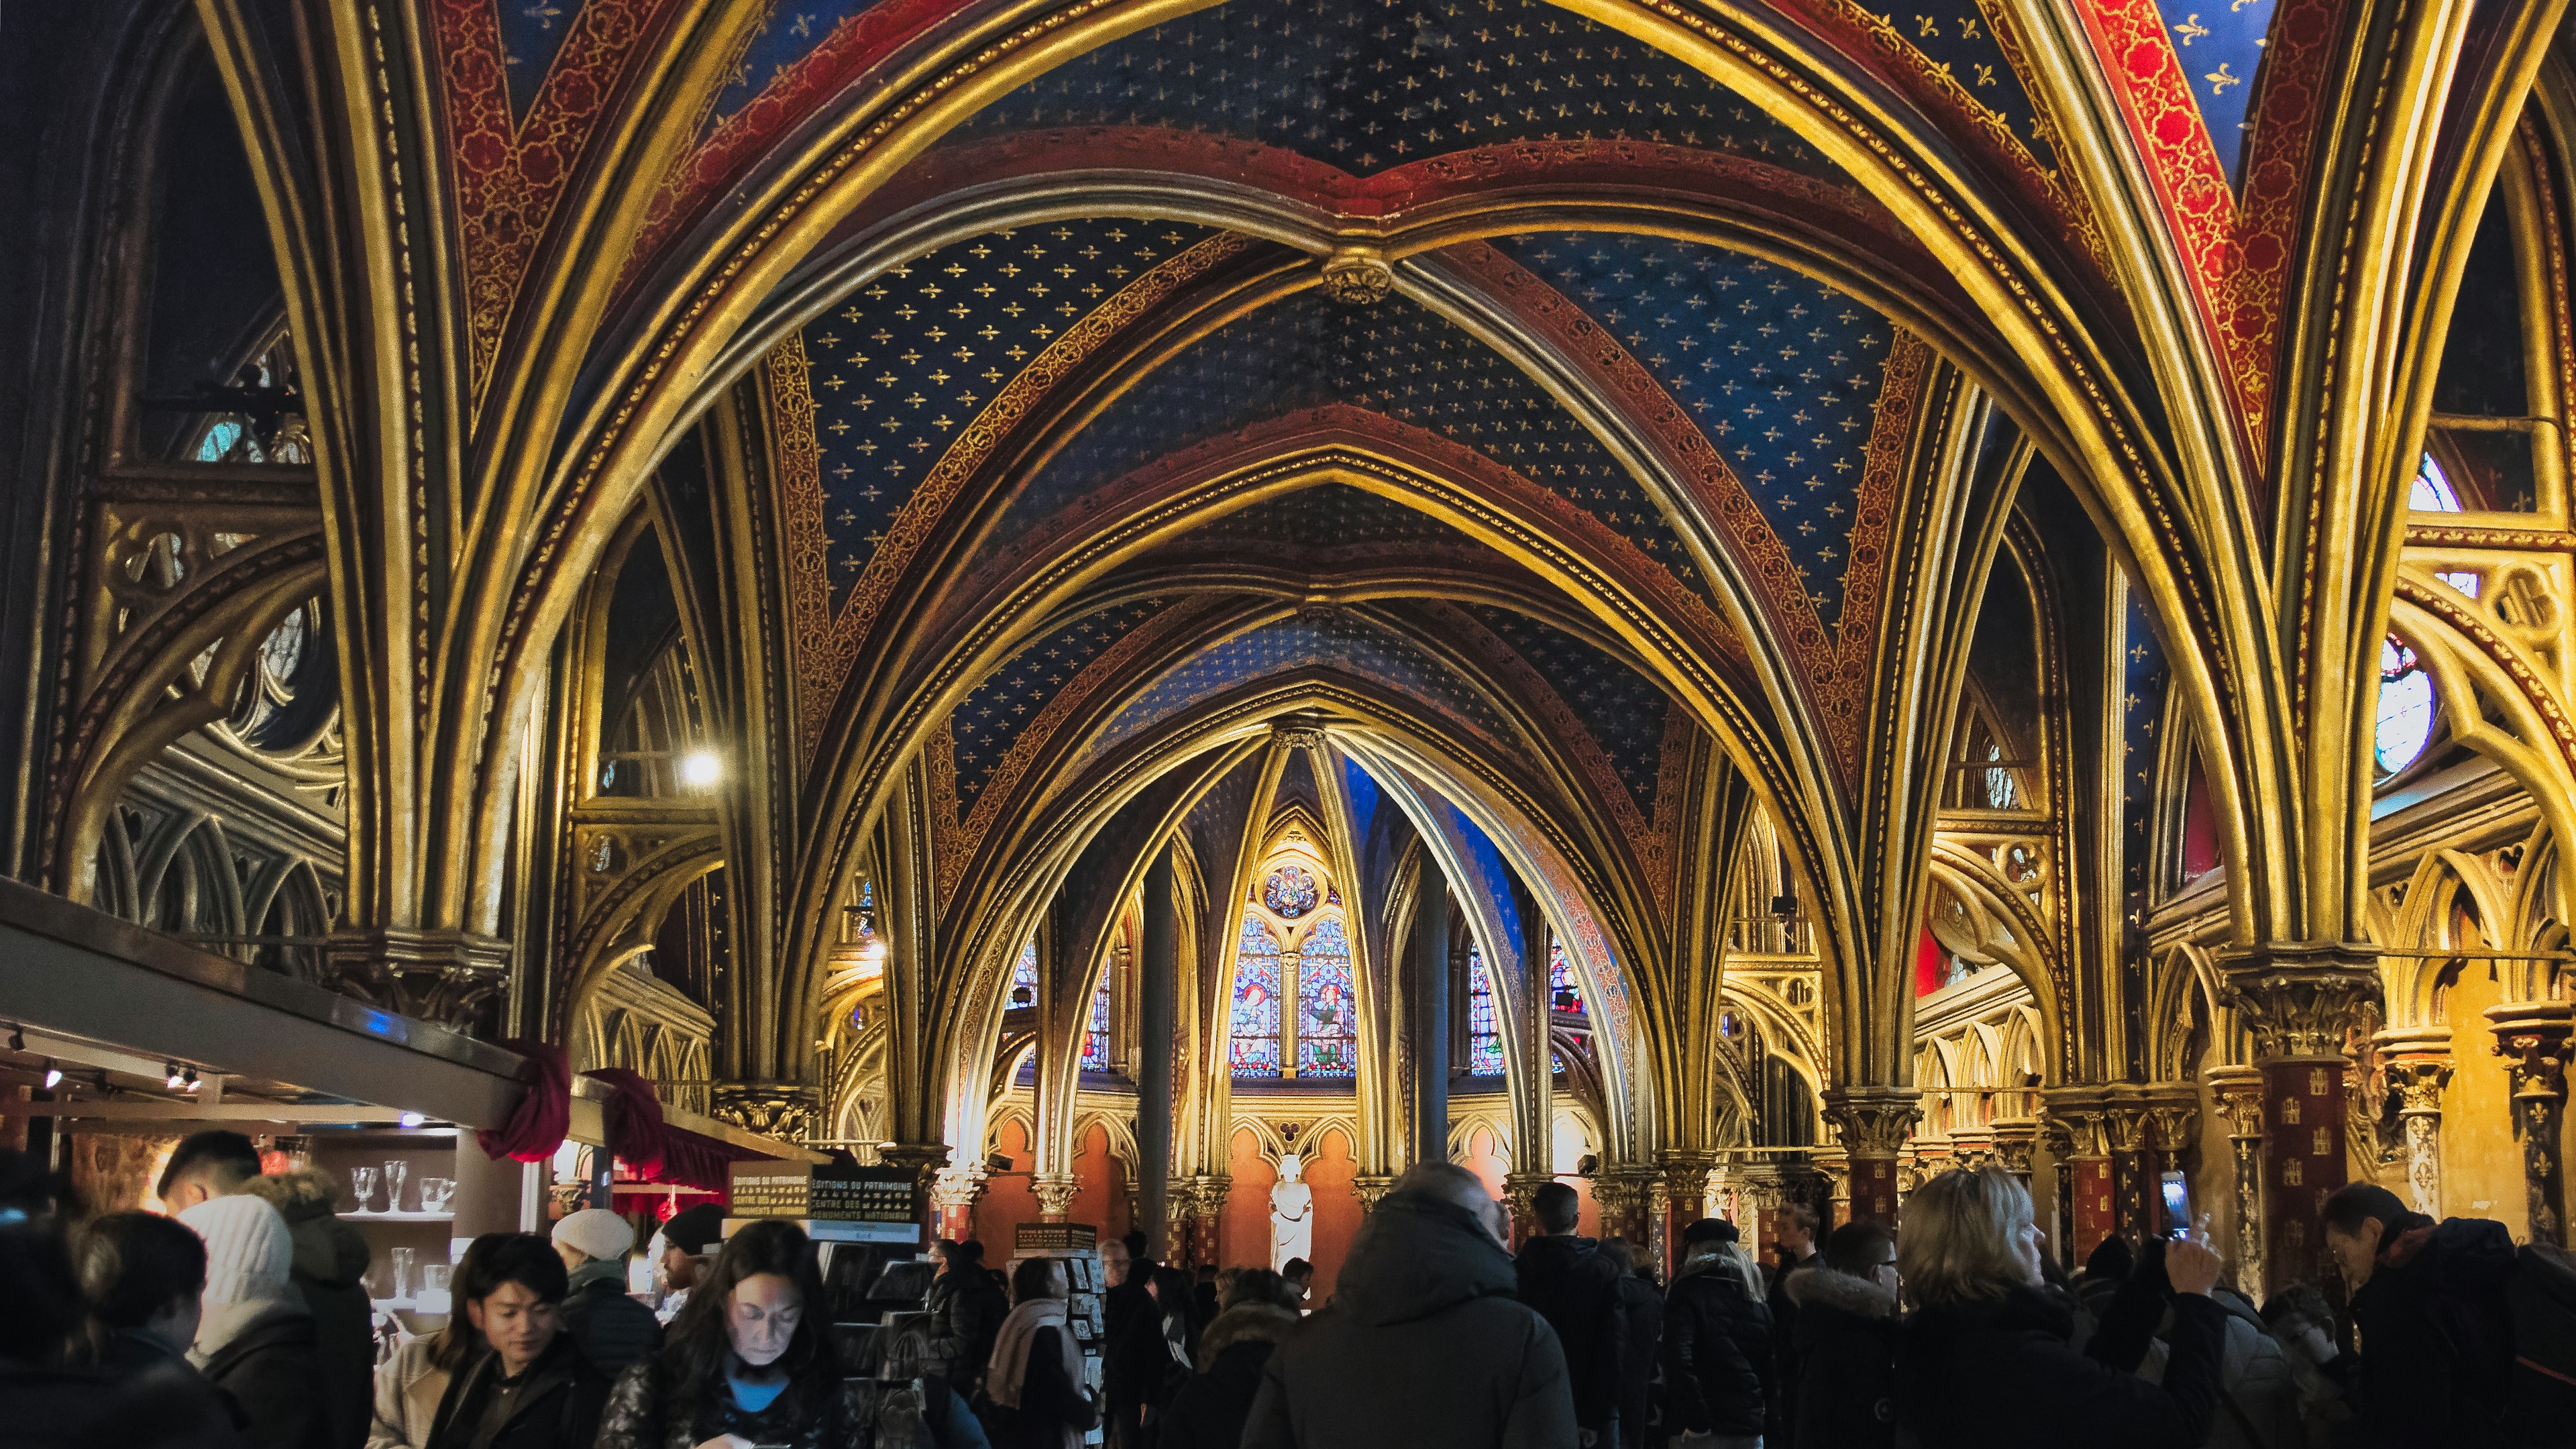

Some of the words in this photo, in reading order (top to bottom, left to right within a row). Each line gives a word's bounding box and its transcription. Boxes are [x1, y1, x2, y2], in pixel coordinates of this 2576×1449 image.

[851, 1181, 861, 1189] DU
[864, 1181, 912, 1191] PATRIMOINE
[845, 1200, 860, 1209] DES
[864, 1211, 910, 1220] NATIONAUX
